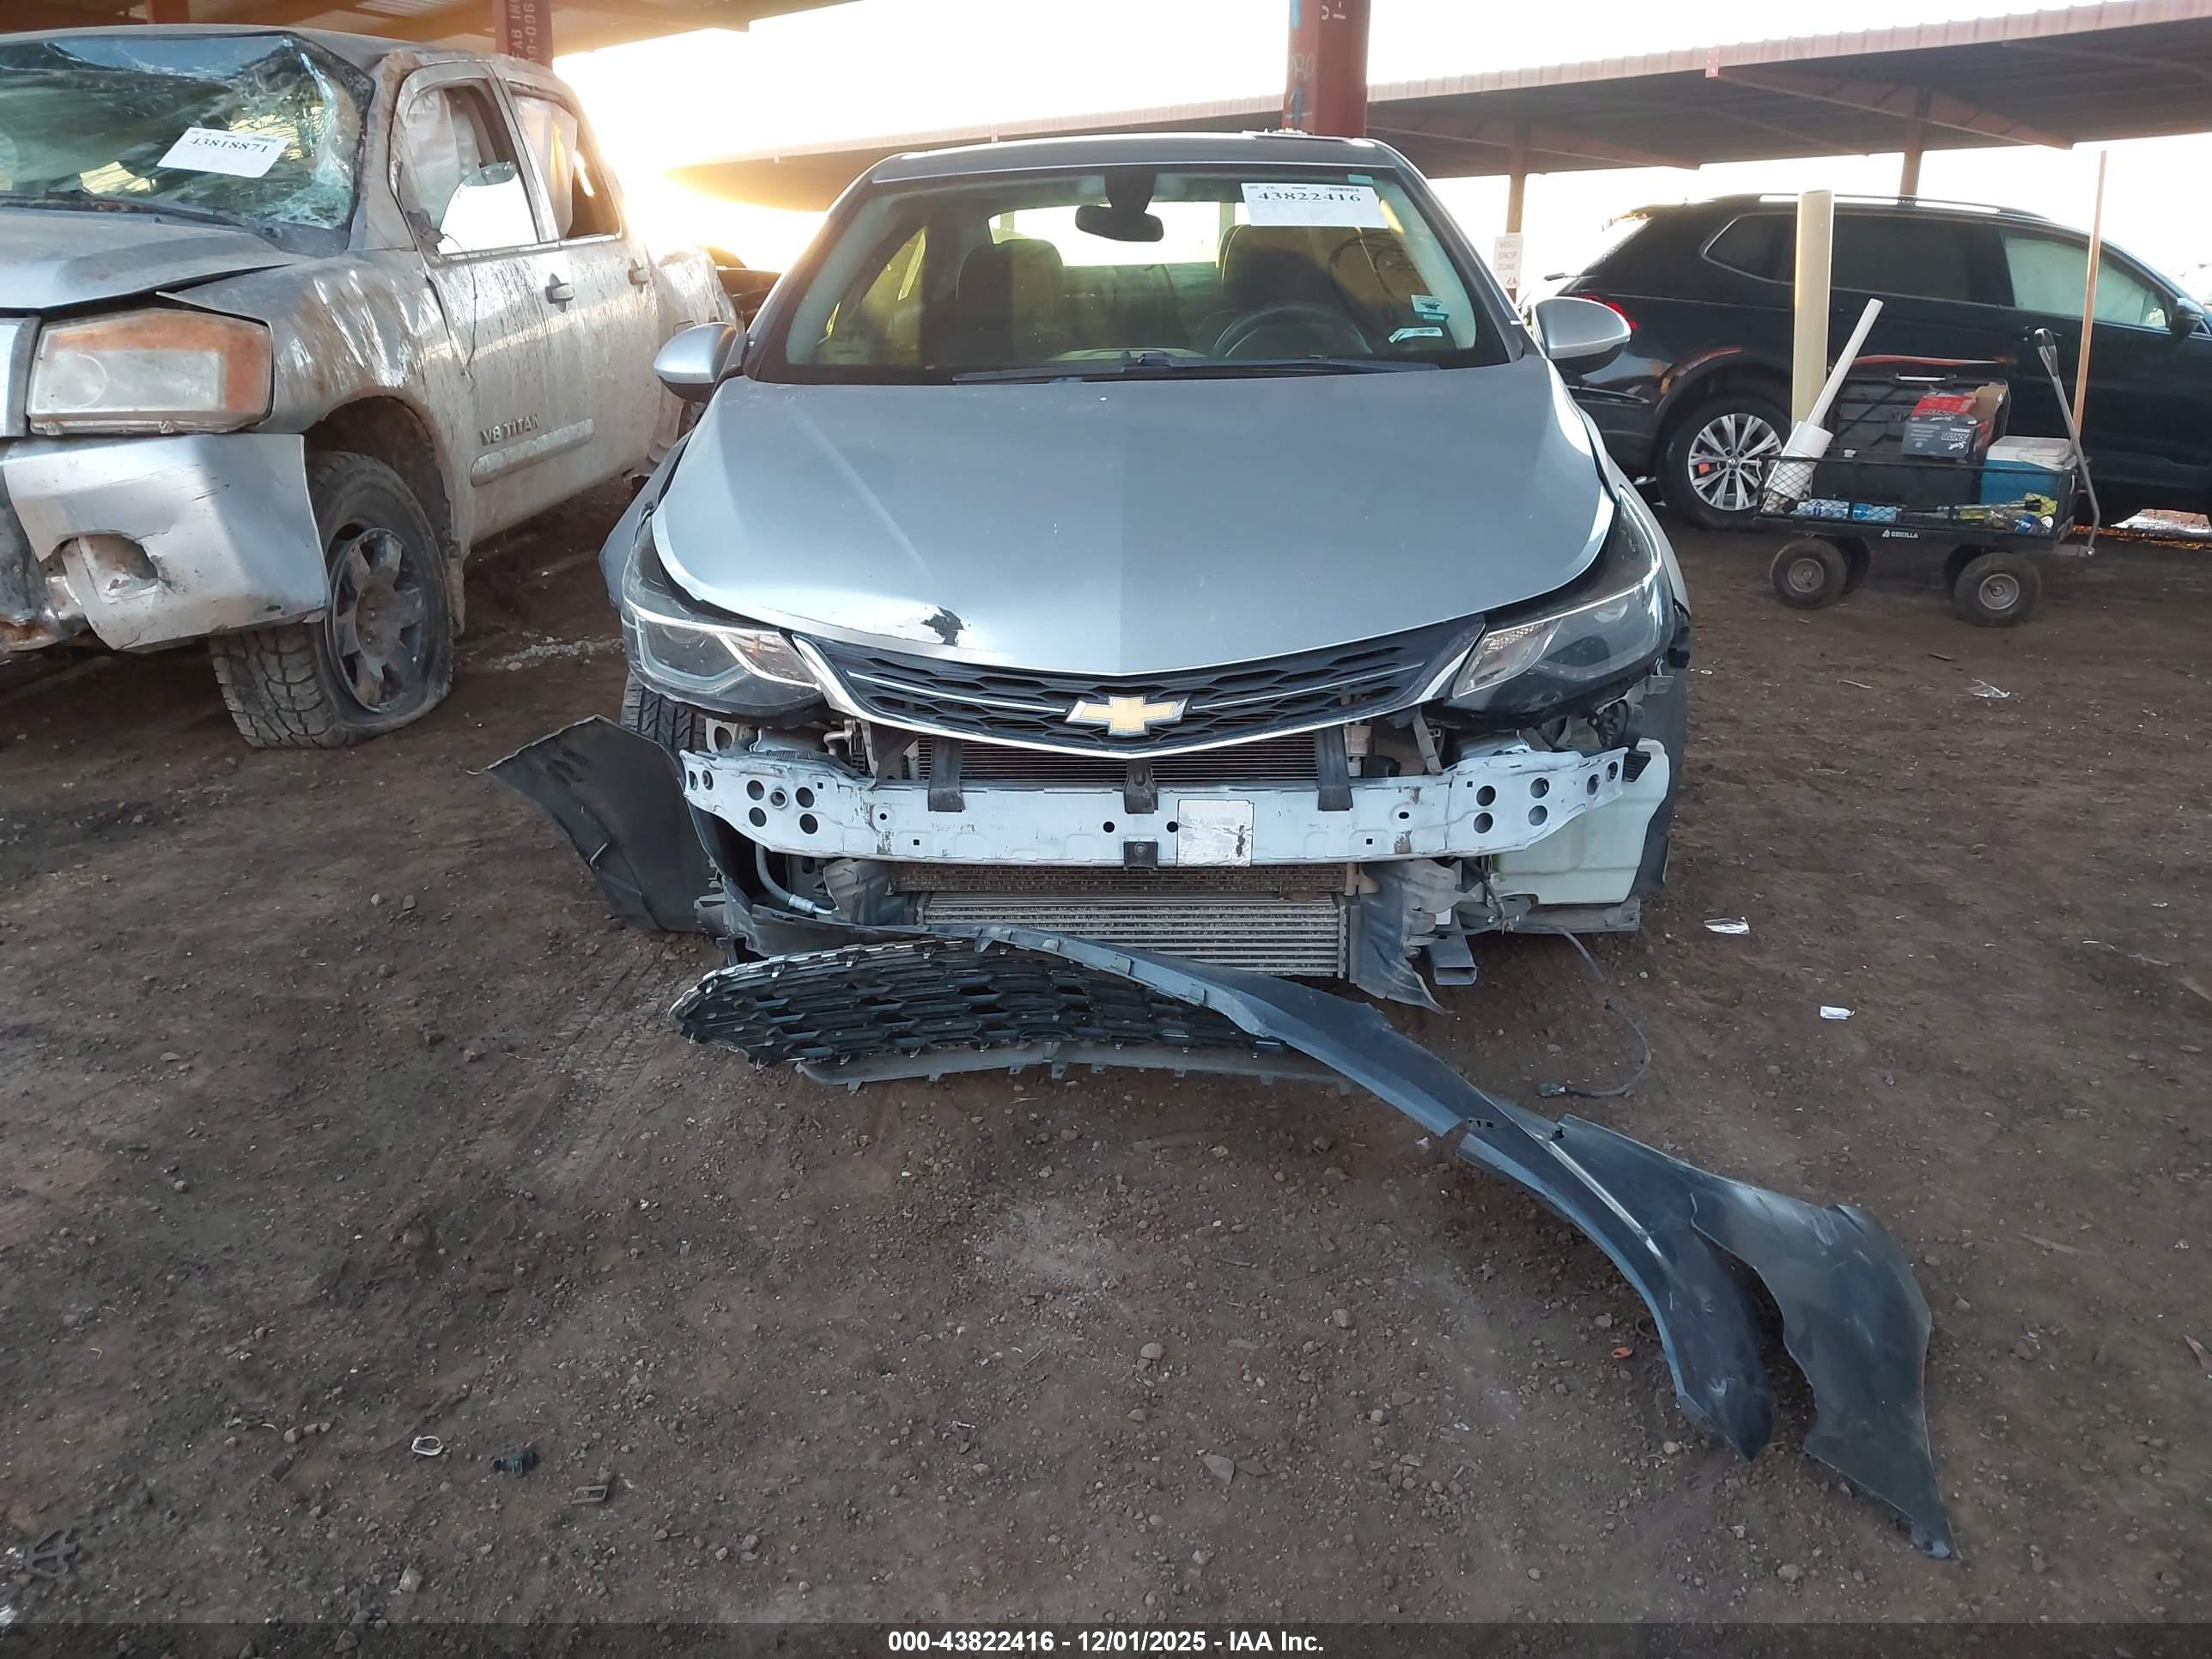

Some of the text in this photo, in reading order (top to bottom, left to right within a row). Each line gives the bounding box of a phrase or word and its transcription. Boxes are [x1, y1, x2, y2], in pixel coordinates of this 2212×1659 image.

[189, 137, 269, 153] 43818871
[1257, 191, 1361, 202] 43822416
[480, 412, 541, 445] V8 TITAN
